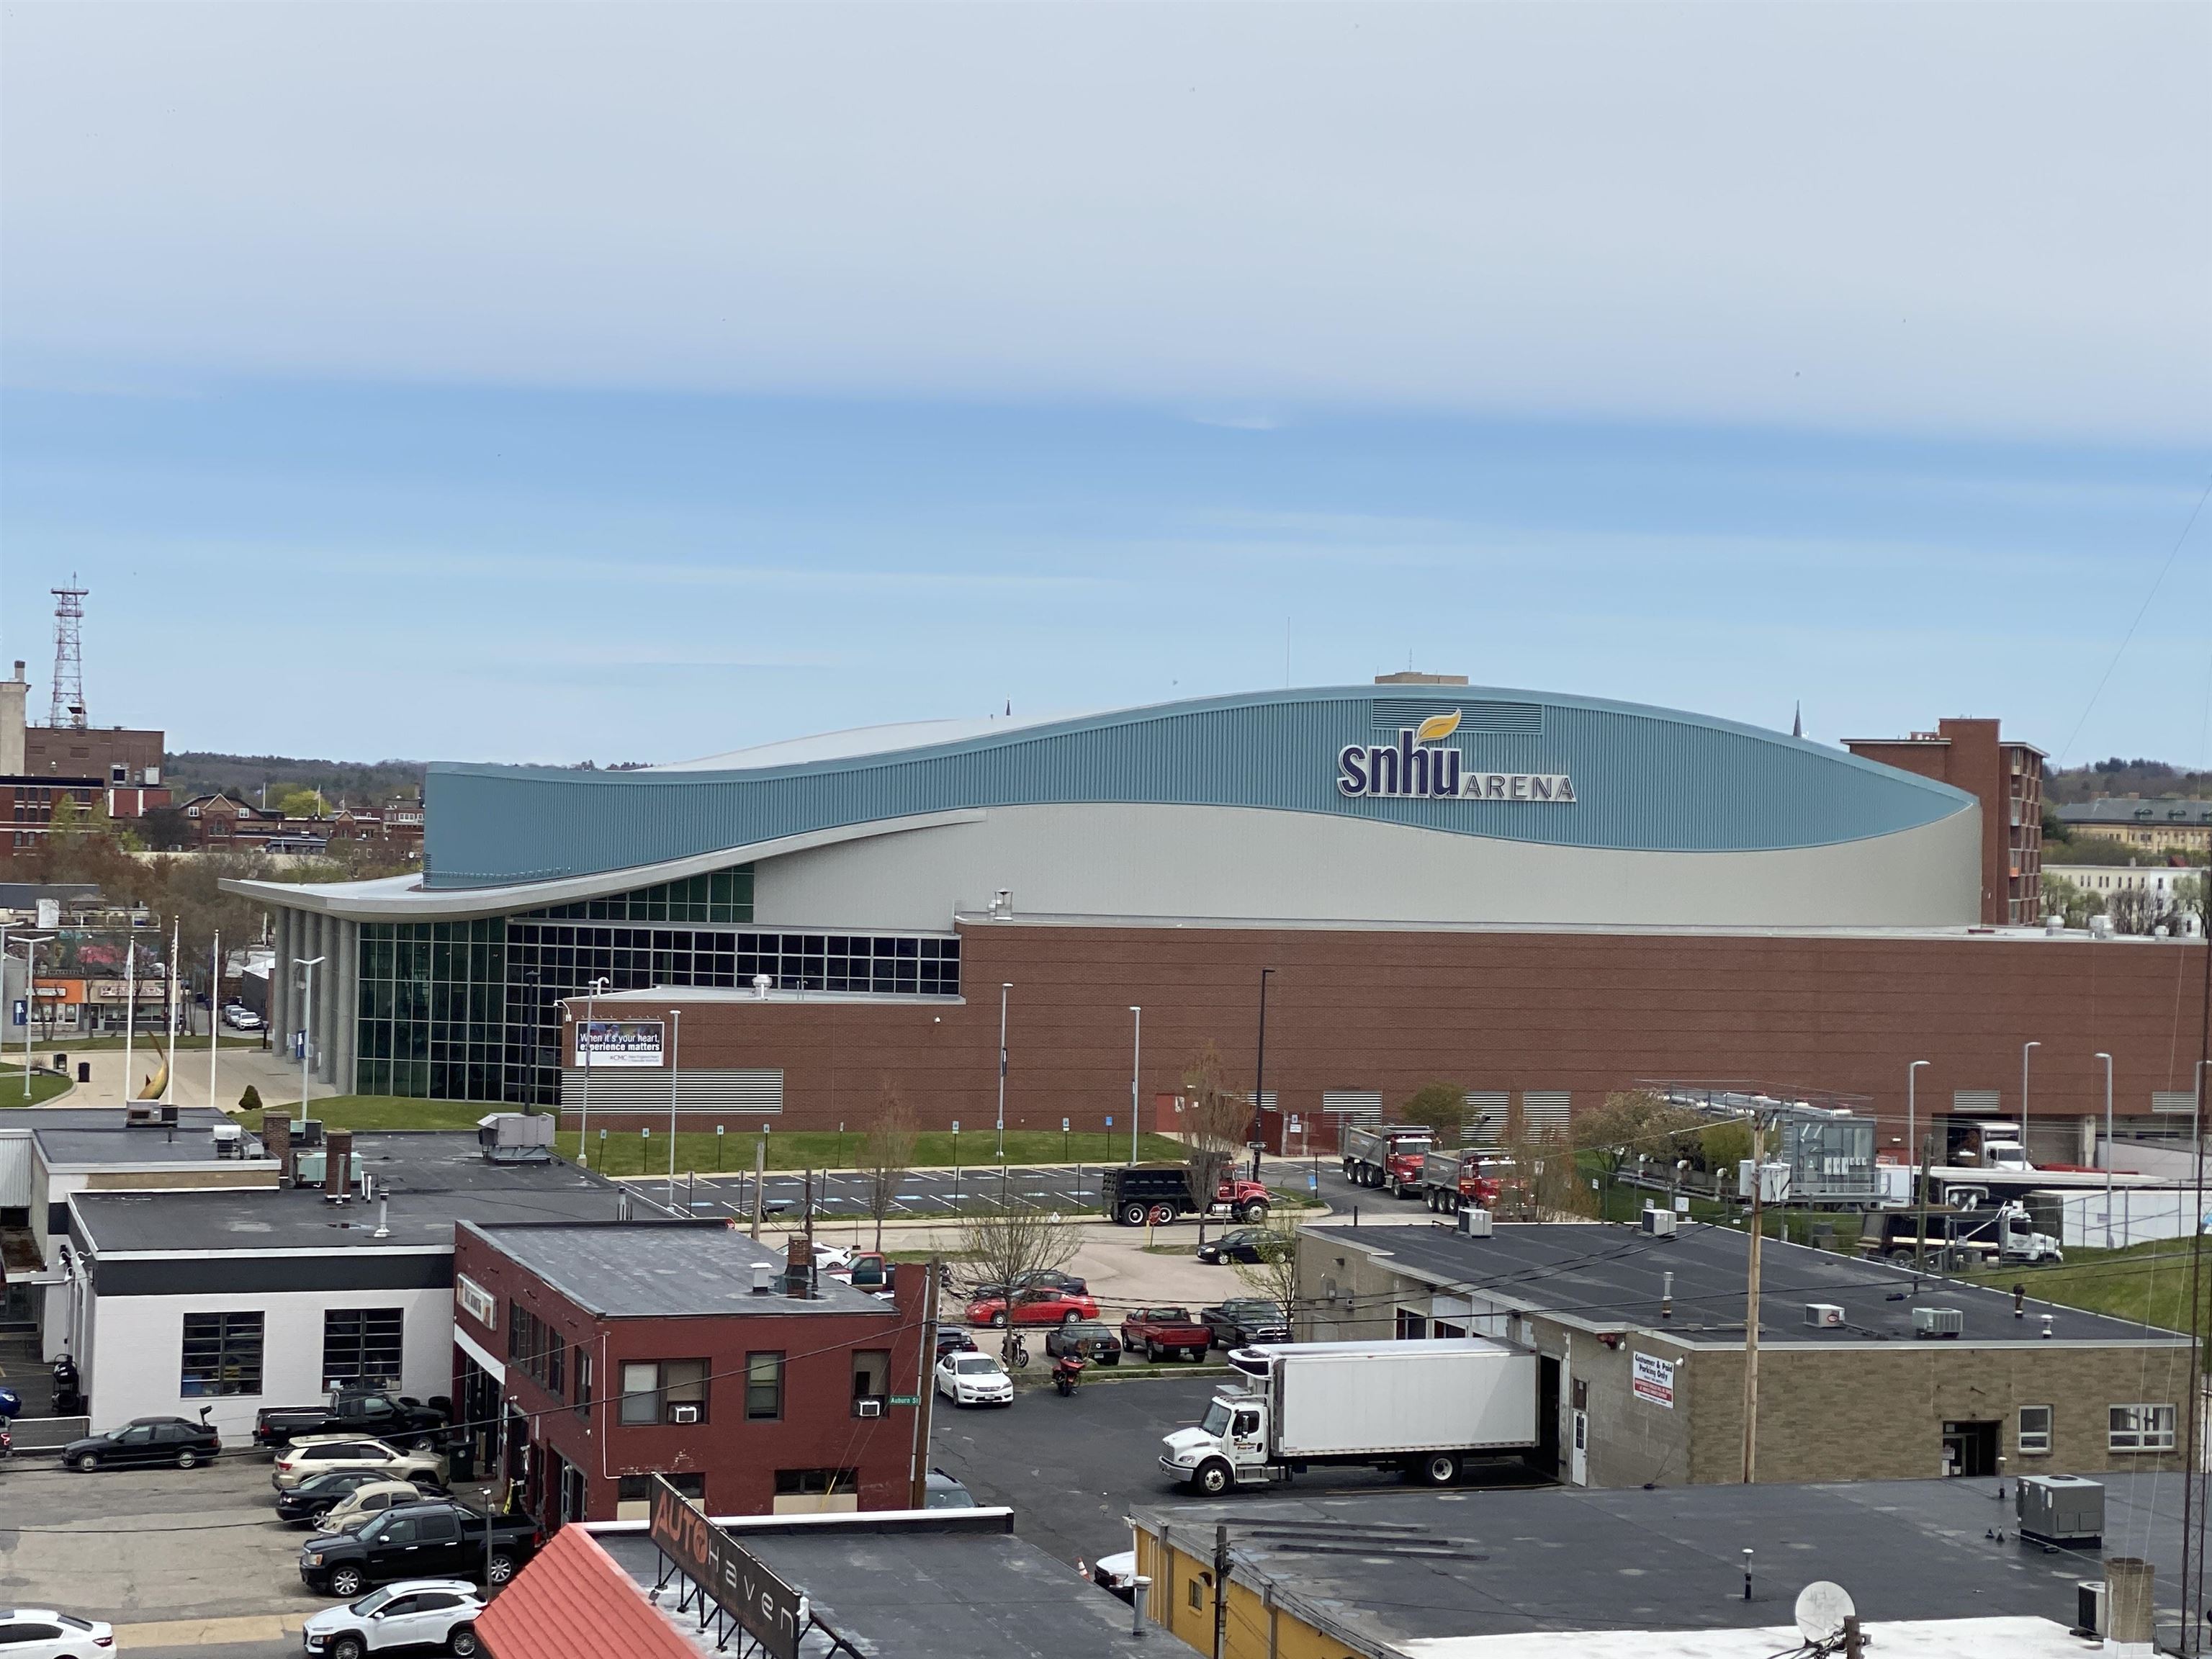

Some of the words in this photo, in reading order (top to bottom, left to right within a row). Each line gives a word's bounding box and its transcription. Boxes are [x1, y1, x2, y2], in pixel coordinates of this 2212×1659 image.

[1339, 729, 1461, 796] snhu
[1463, 775, 1575, 801] ARENA
[605, 1033, 619, 1042] it's
[619, 1035, 636, 1044] your
[637, 1033, 660, 1043] heart,
[1635, 1353, 1655, 1367] Customer
[1656, 1360, 1660, 1369] &
[1662, 1362, 1673, 1373] Paid
[1639, 1363, 1656, 1377] Parking
[1657, 1370, 1668, 1382] Only
